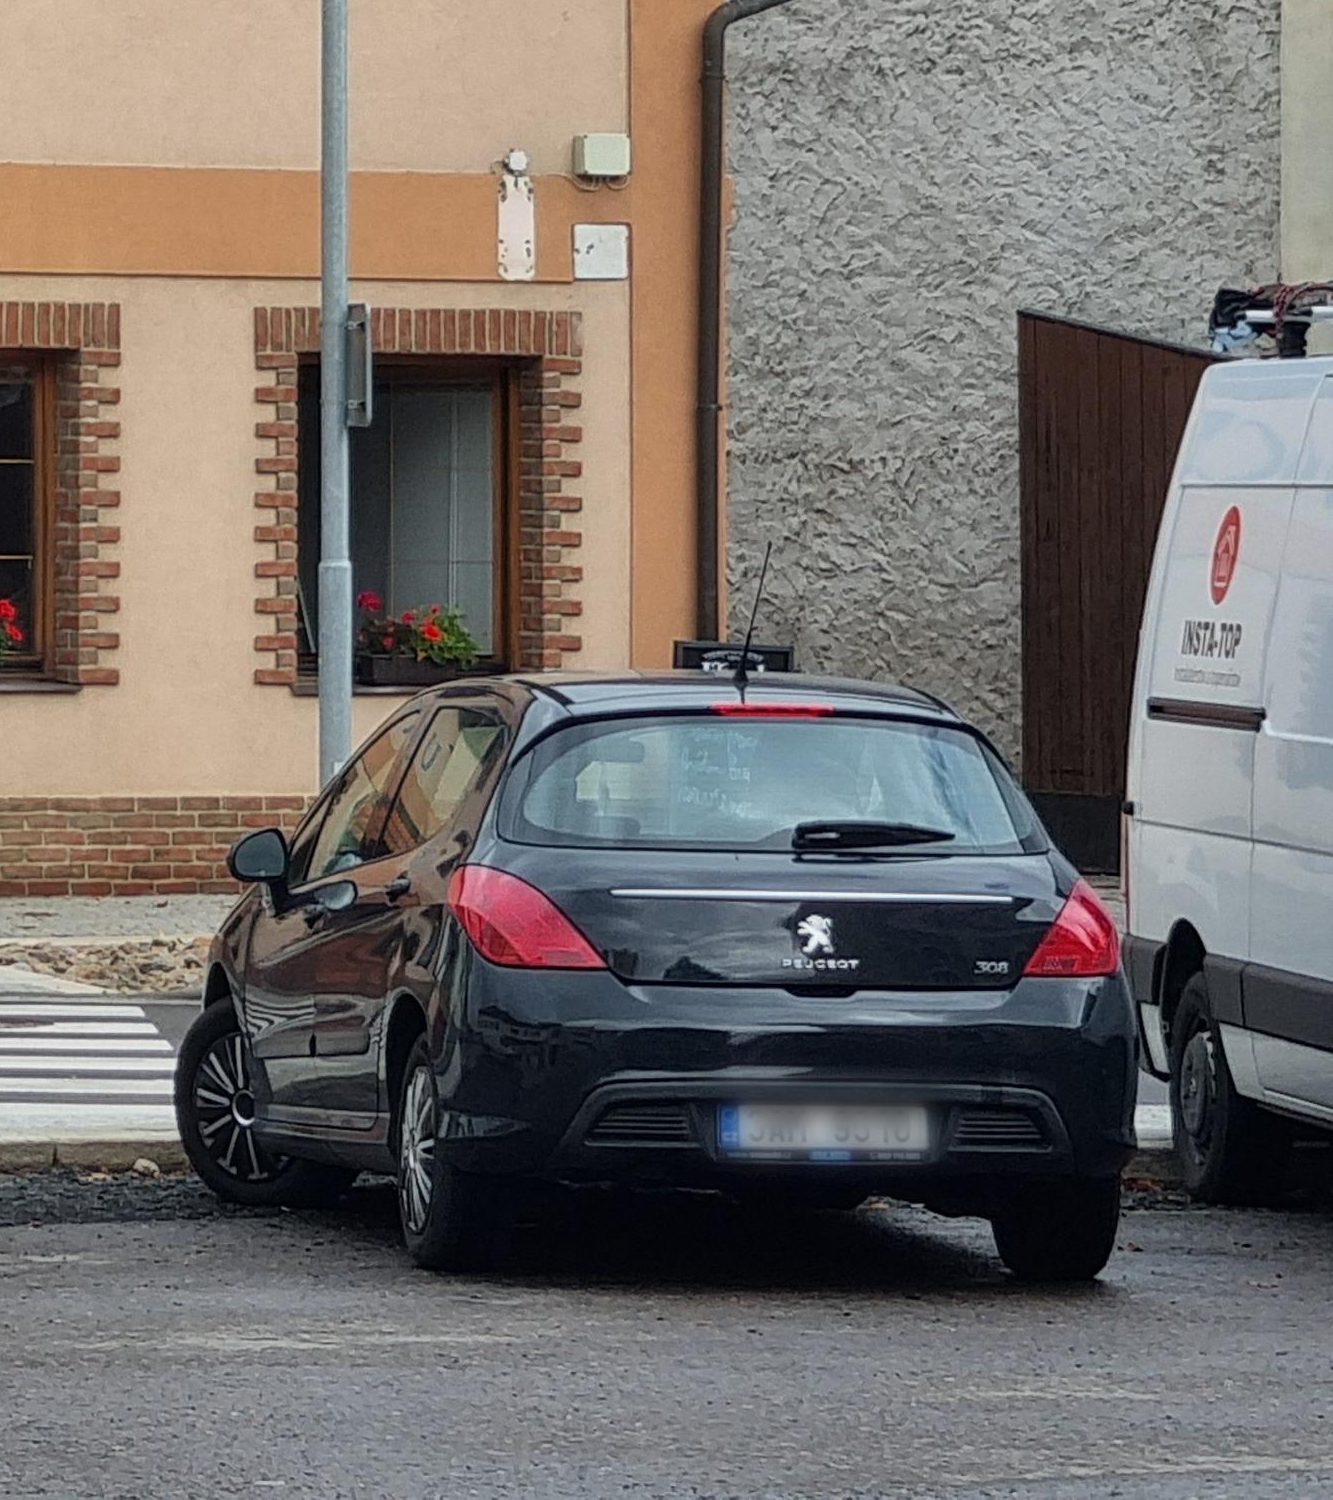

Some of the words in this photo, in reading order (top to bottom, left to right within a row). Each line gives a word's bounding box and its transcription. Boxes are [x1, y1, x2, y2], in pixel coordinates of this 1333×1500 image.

[1181, 620, 1242, 659] INSTA-TOP
[781, 958, 860, 970] PEUGEOT
[973, 961, 1009, 974] 308
